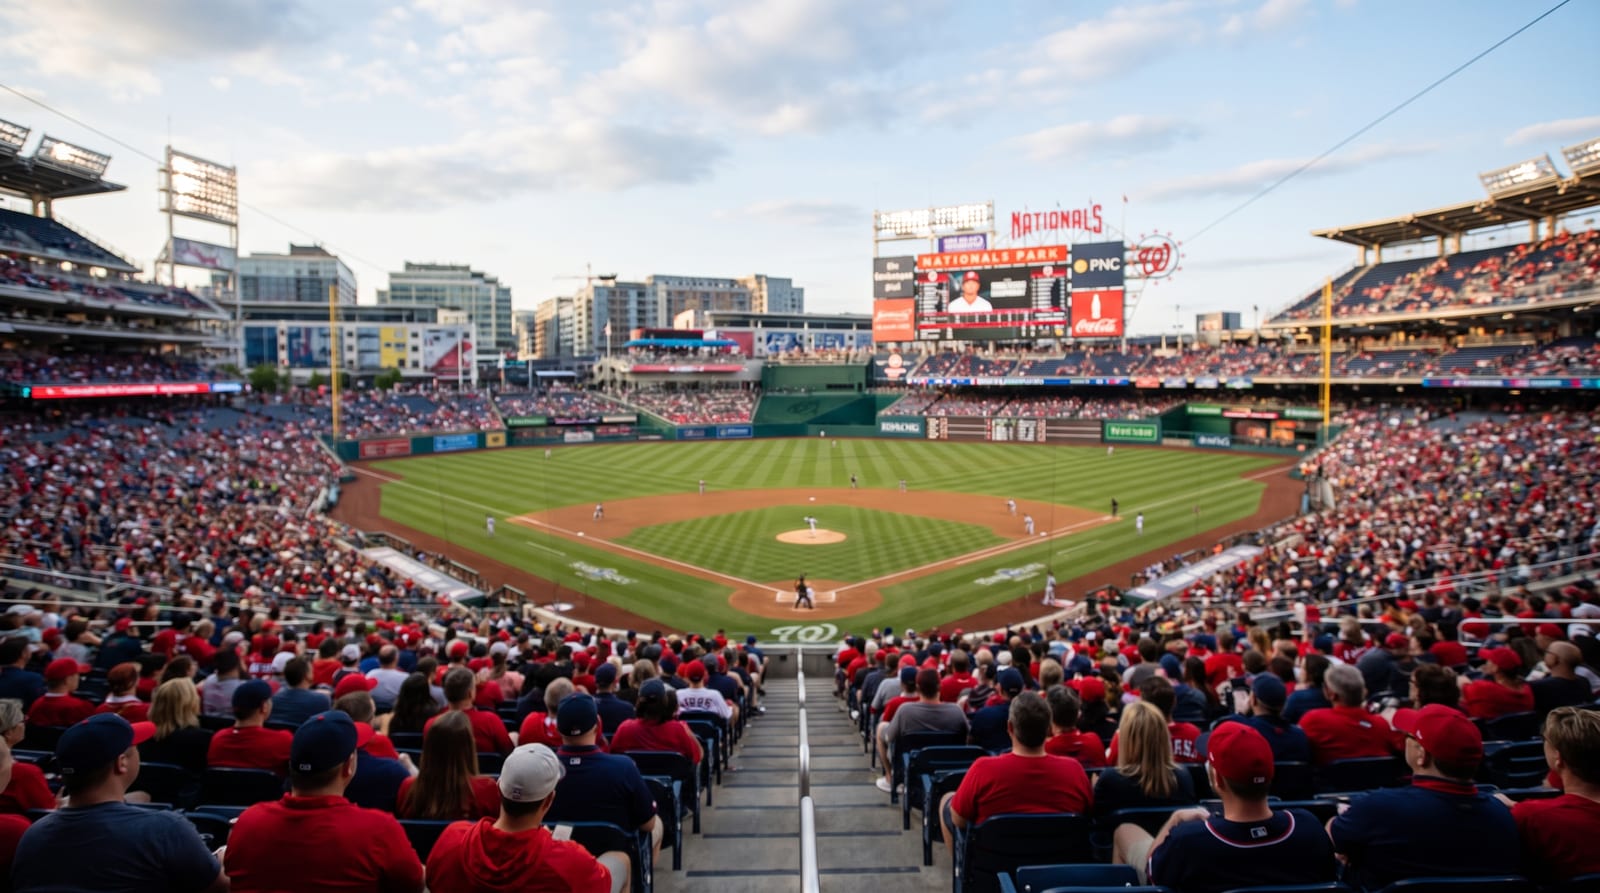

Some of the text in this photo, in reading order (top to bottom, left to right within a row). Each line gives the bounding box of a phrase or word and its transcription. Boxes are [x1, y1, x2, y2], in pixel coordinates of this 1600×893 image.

[1011, 204, 1103, 240] NATIONALS
[922, 247, 1059, 267] NATIONALS PARK
[1089, 257, 1121, 272] PNC
